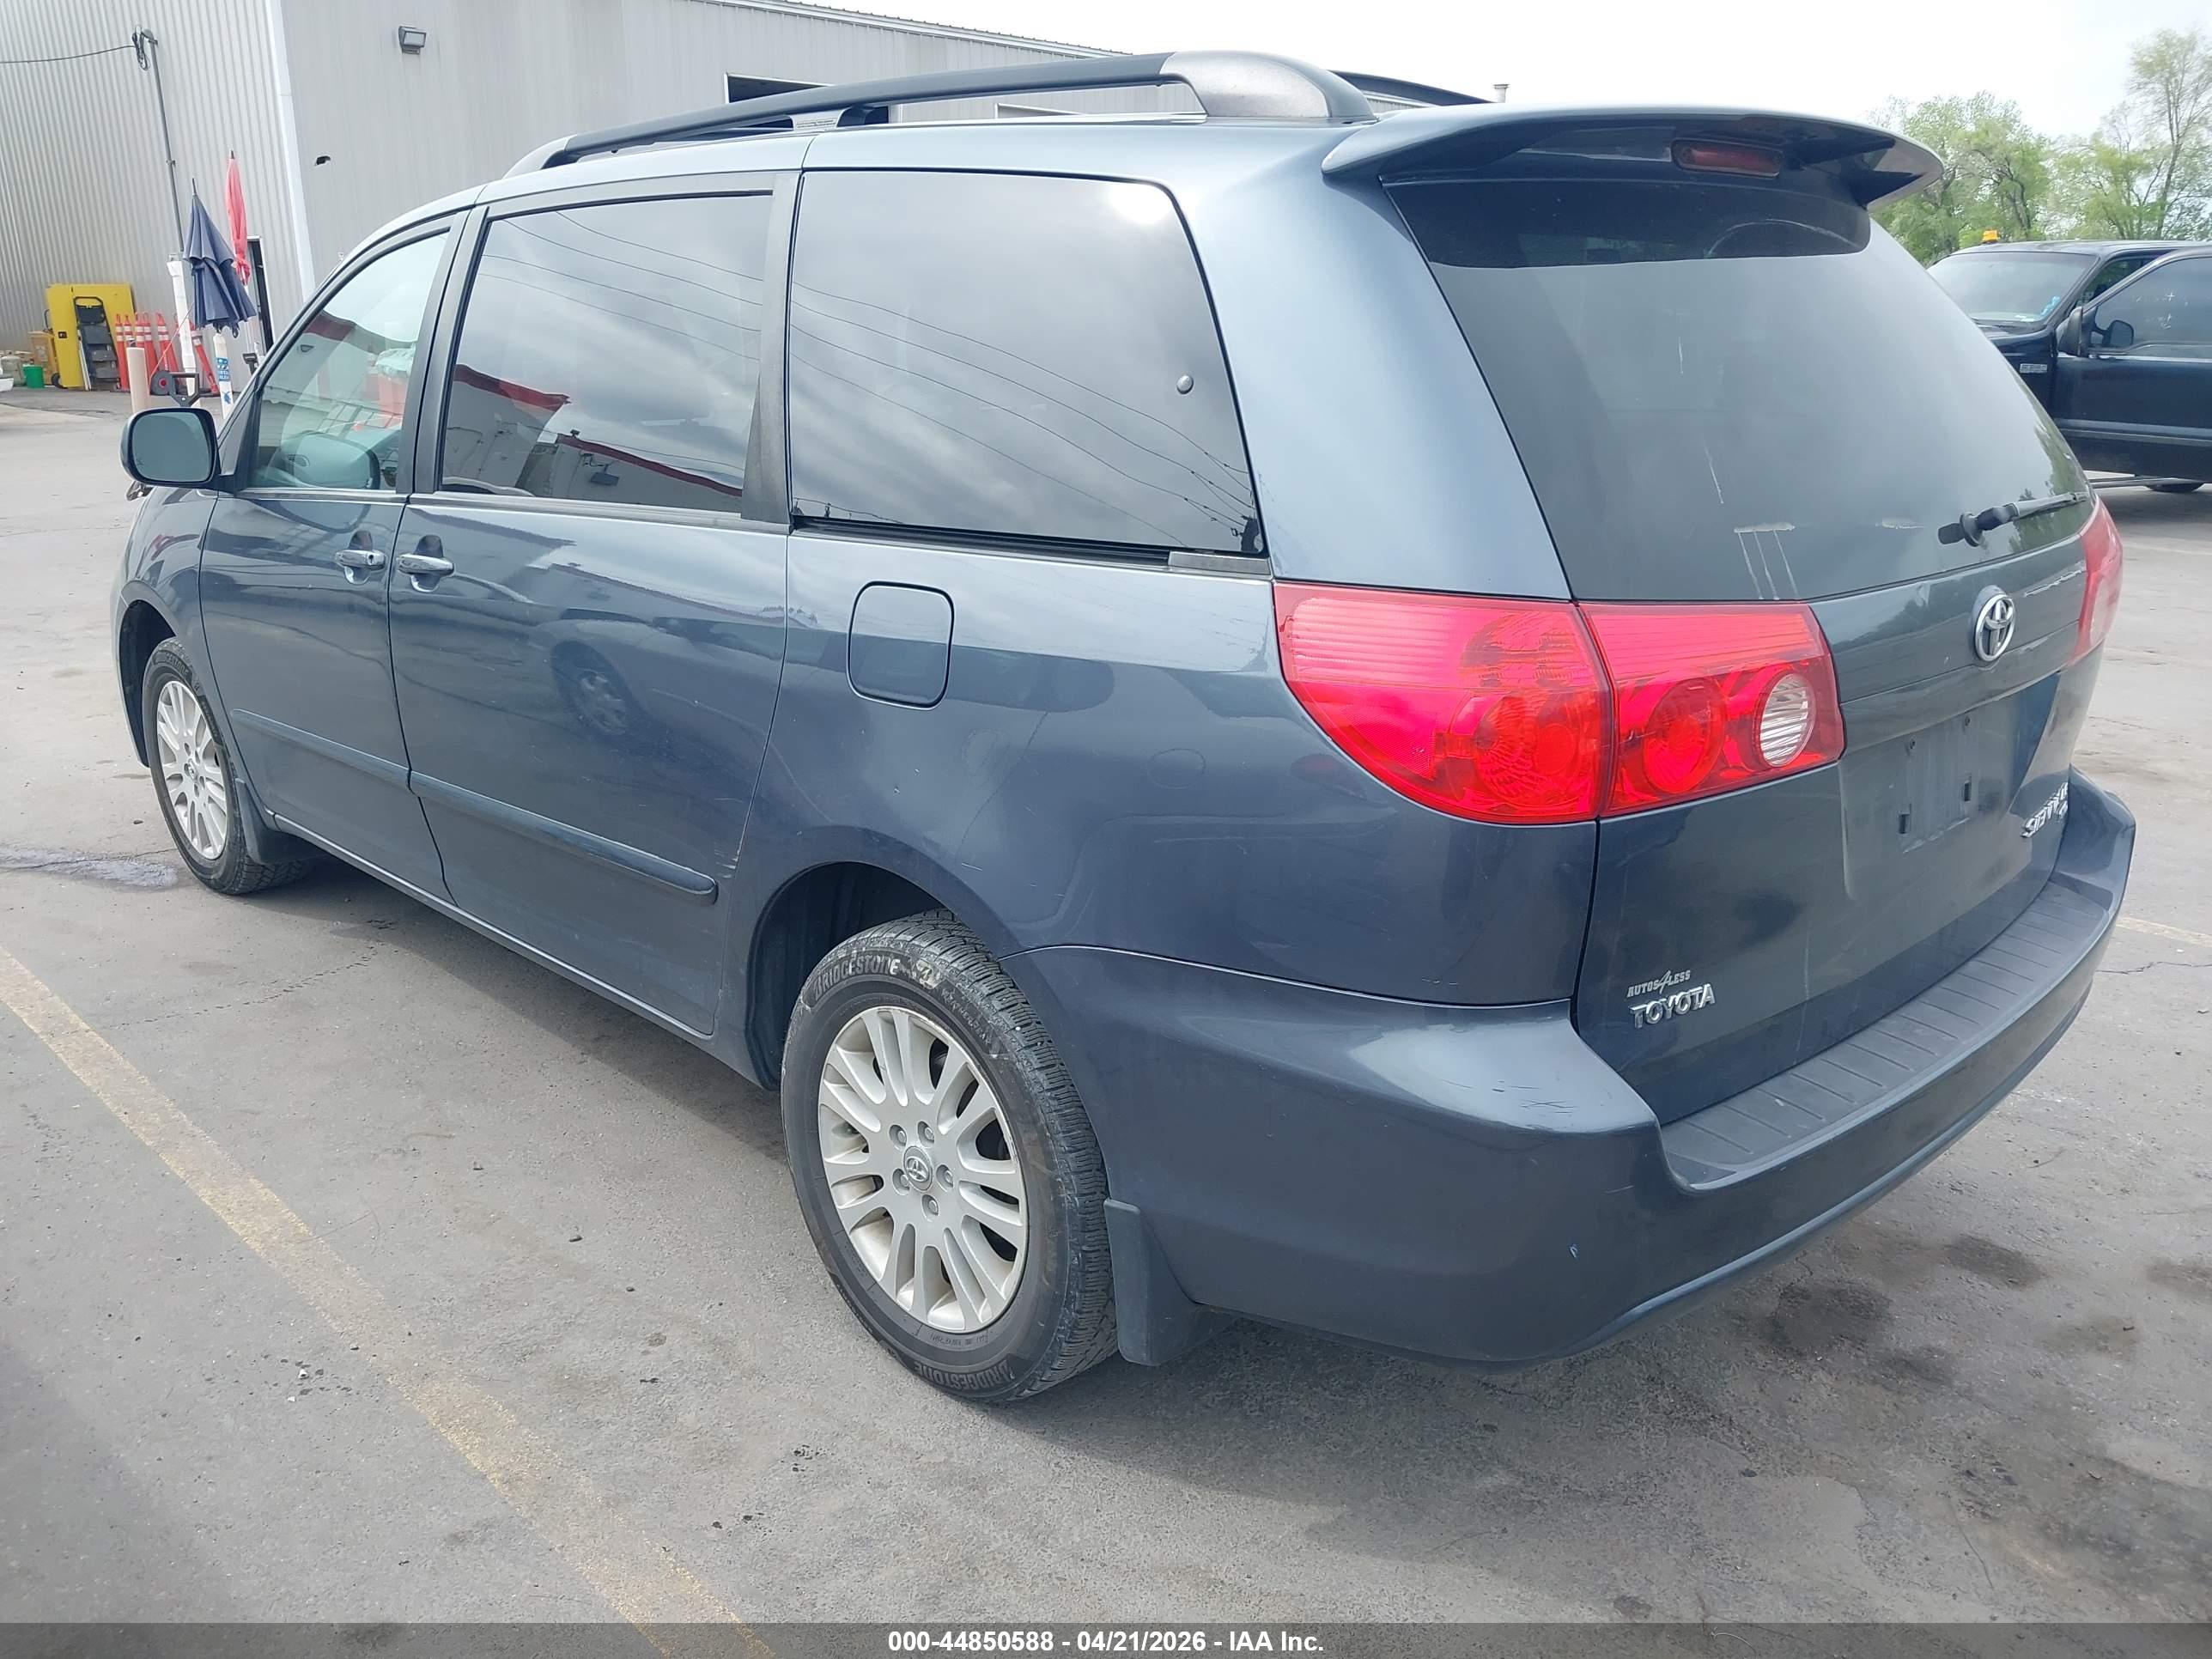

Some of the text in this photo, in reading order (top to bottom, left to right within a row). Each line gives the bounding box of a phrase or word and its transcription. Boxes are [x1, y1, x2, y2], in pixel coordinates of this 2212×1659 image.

[814, 955, 901, 998] BRIDGESTONE
[1629, 983, 1716, 1029] TOYOTA
[914, 1359, 1015, 1390] BRIDGESTONE
